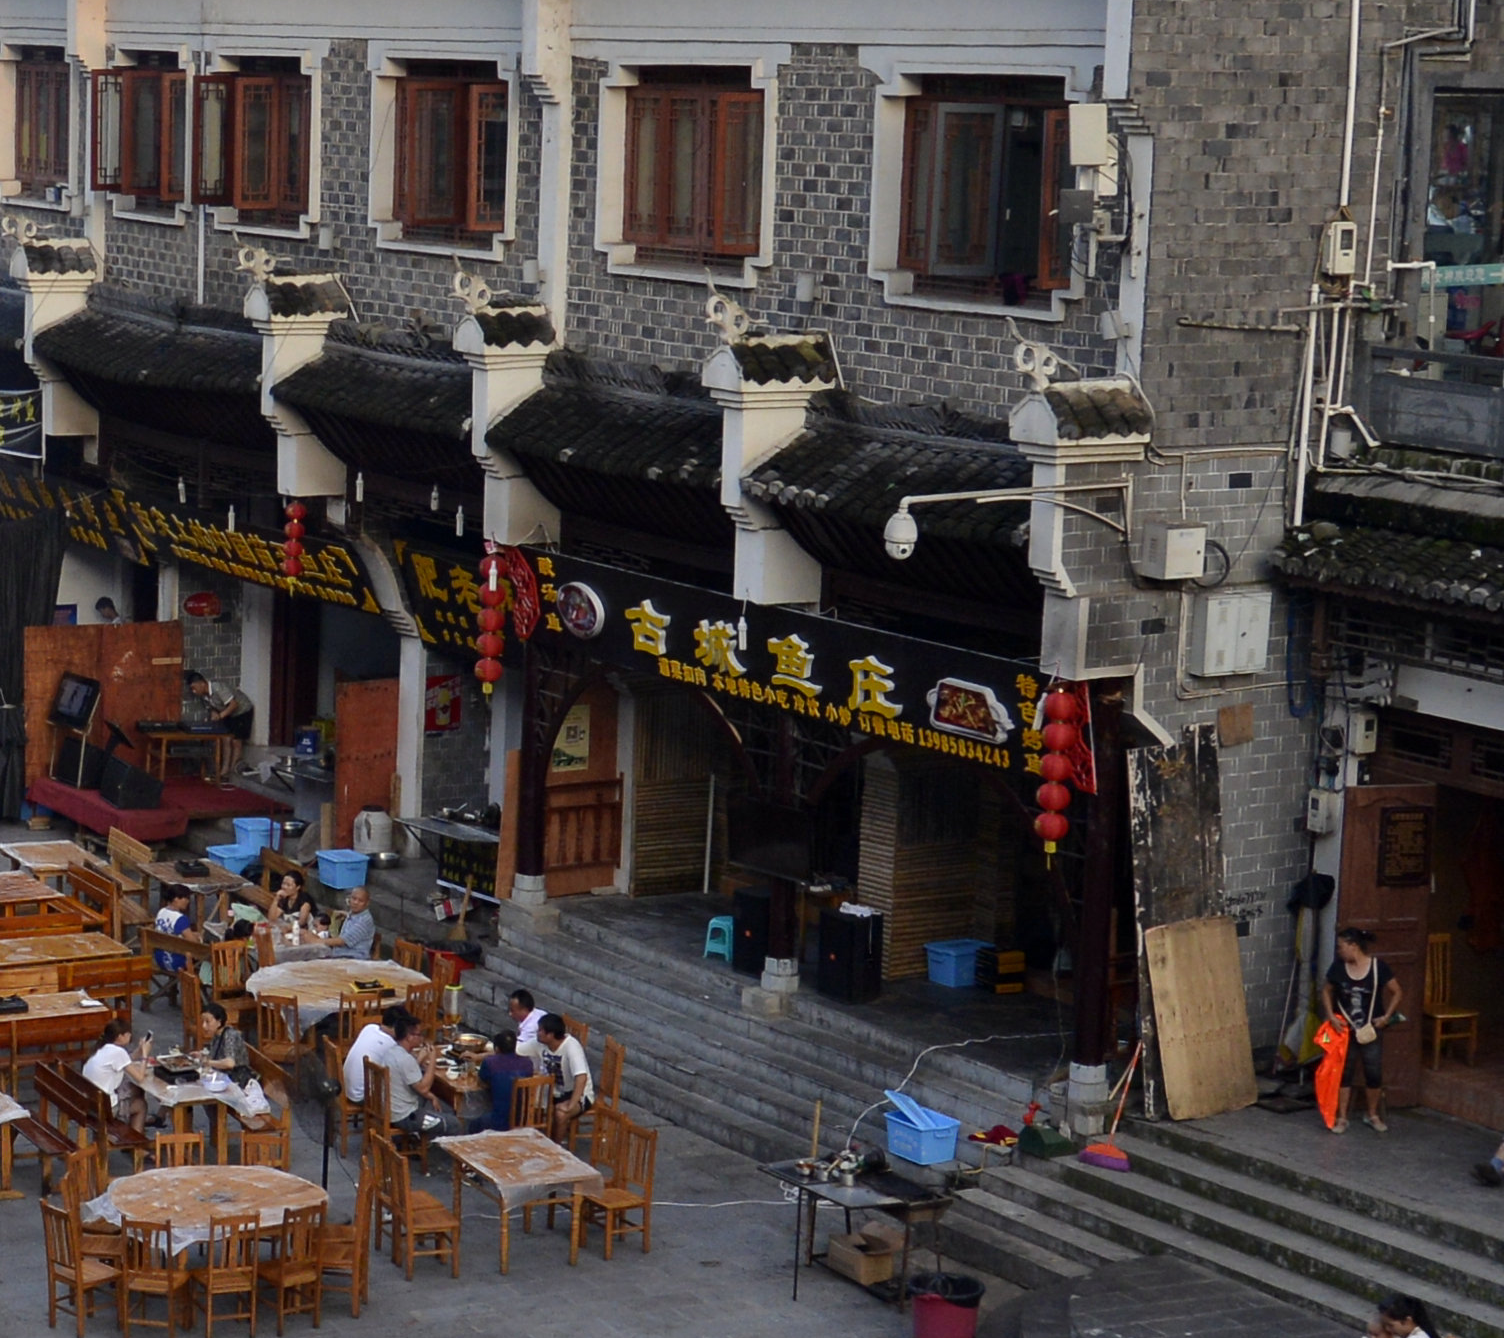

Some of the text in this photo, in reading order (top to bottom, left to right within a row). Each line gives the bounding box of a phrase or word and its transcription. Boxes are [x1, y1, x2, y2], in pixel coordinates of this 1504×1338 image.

[625, 599, 903, 719] 古城鱼庄
[712, 672, 791, 710] 本地特色小吃
[858, 713, 915, 745] 订餐电话
[1016, 673, 1043, 775] 特色烤鱼
